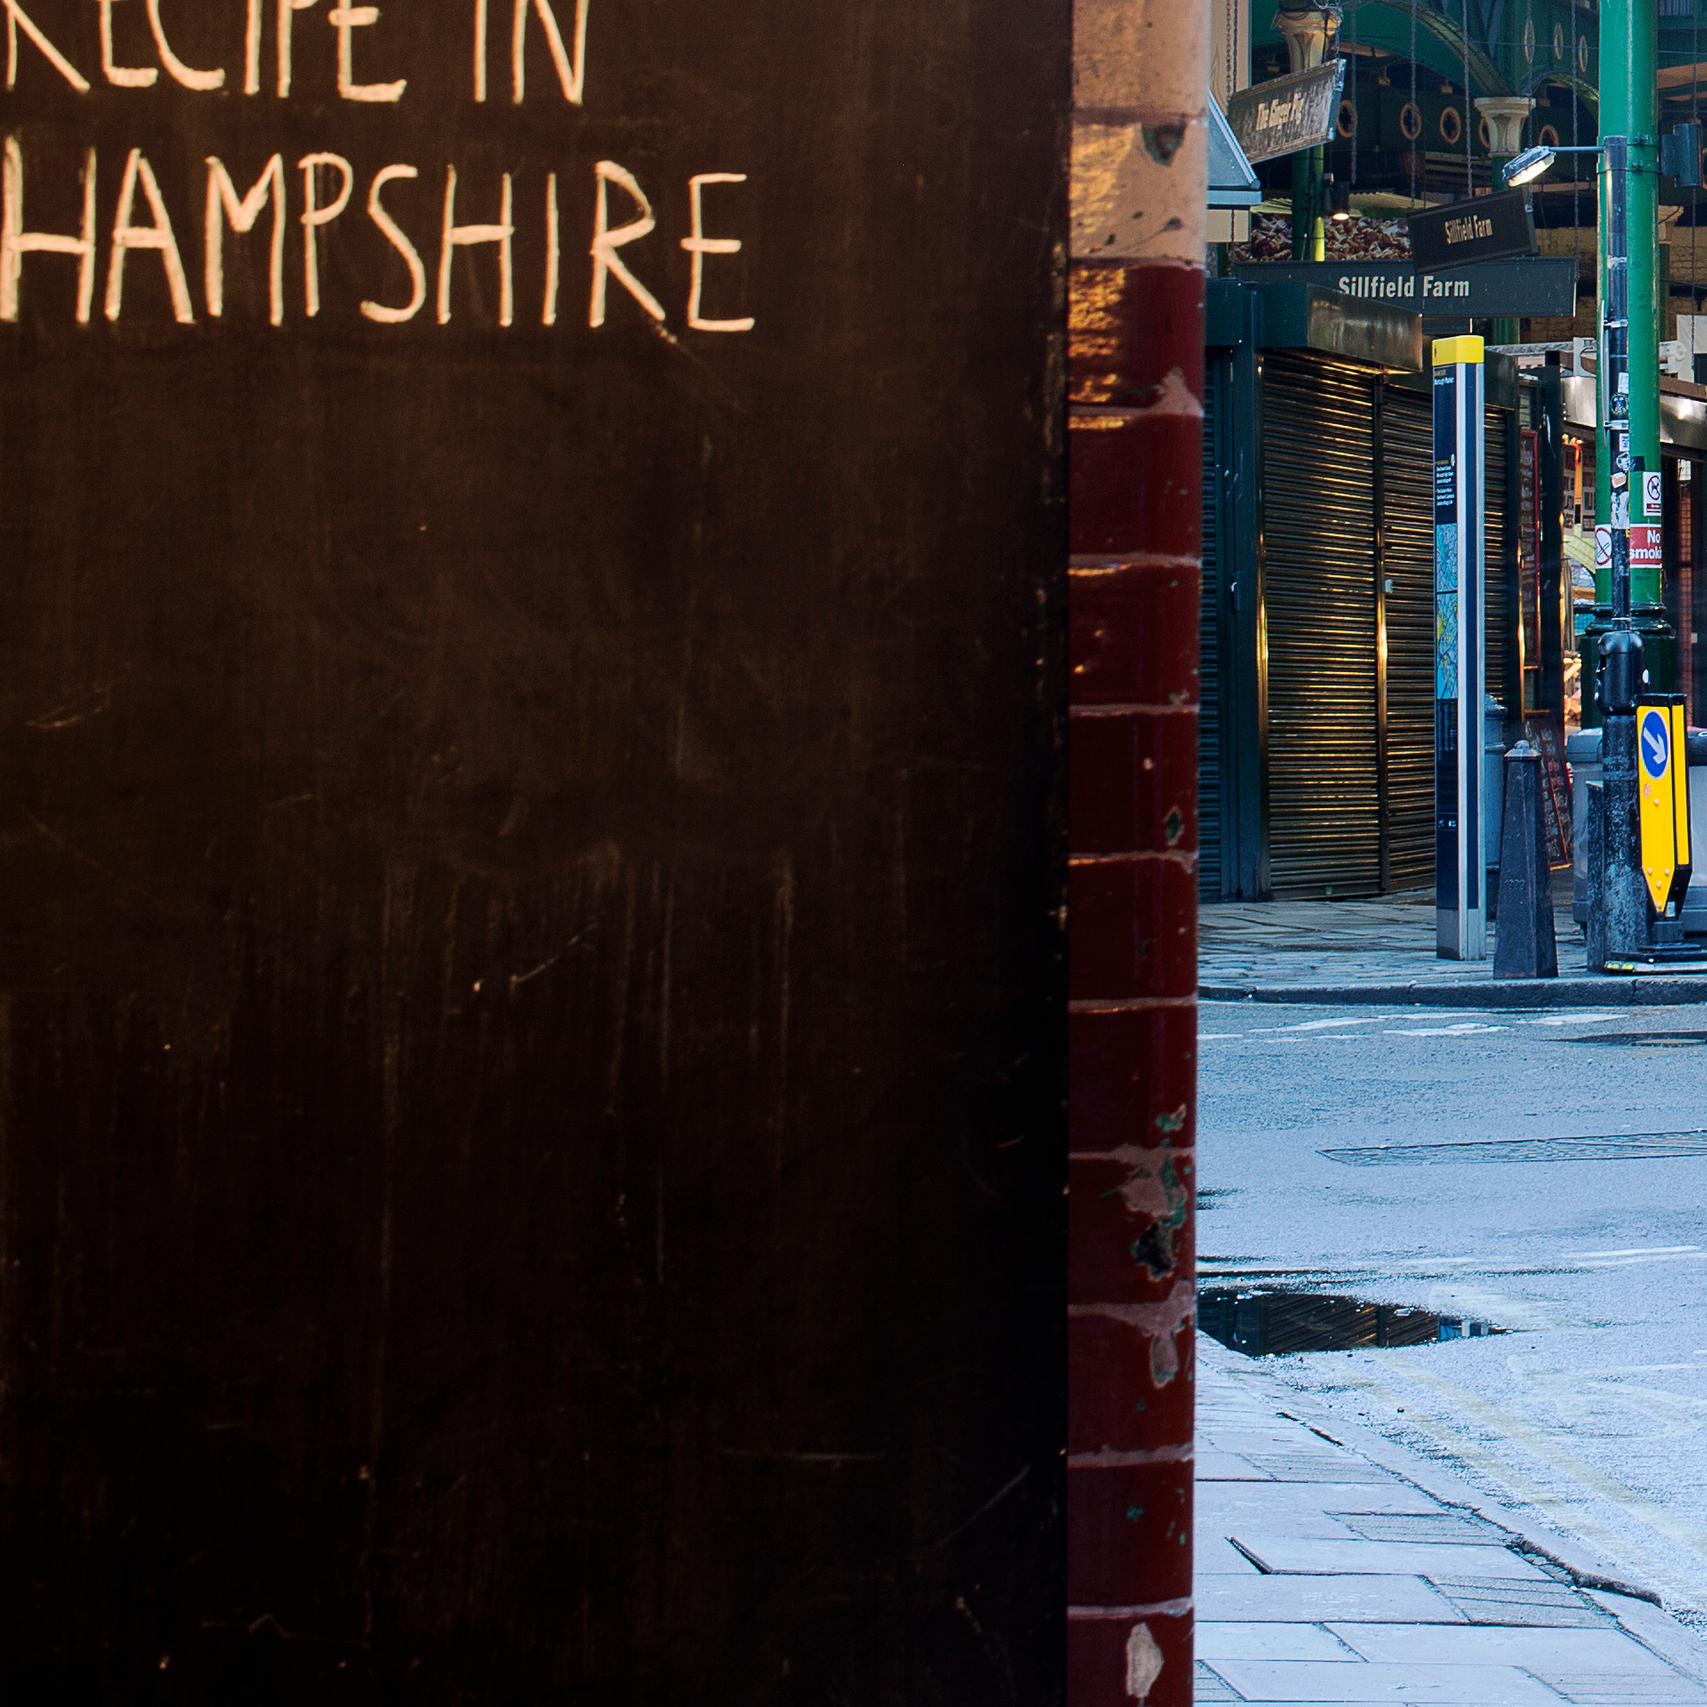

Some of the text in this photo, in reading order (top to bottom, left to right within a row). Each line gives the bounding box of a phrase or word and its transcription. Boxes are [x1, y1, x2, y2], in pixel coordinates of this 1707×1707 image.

[0, 135, 756, 332] HAMPSHIRE
[1444, 215, 1494, 244] Sillfield Farm
[1338, 275, 1470, 297] Sillfield Farm
[1647, 529, 1661, 544] No
[1629, 545, 1663, 560] smoki
